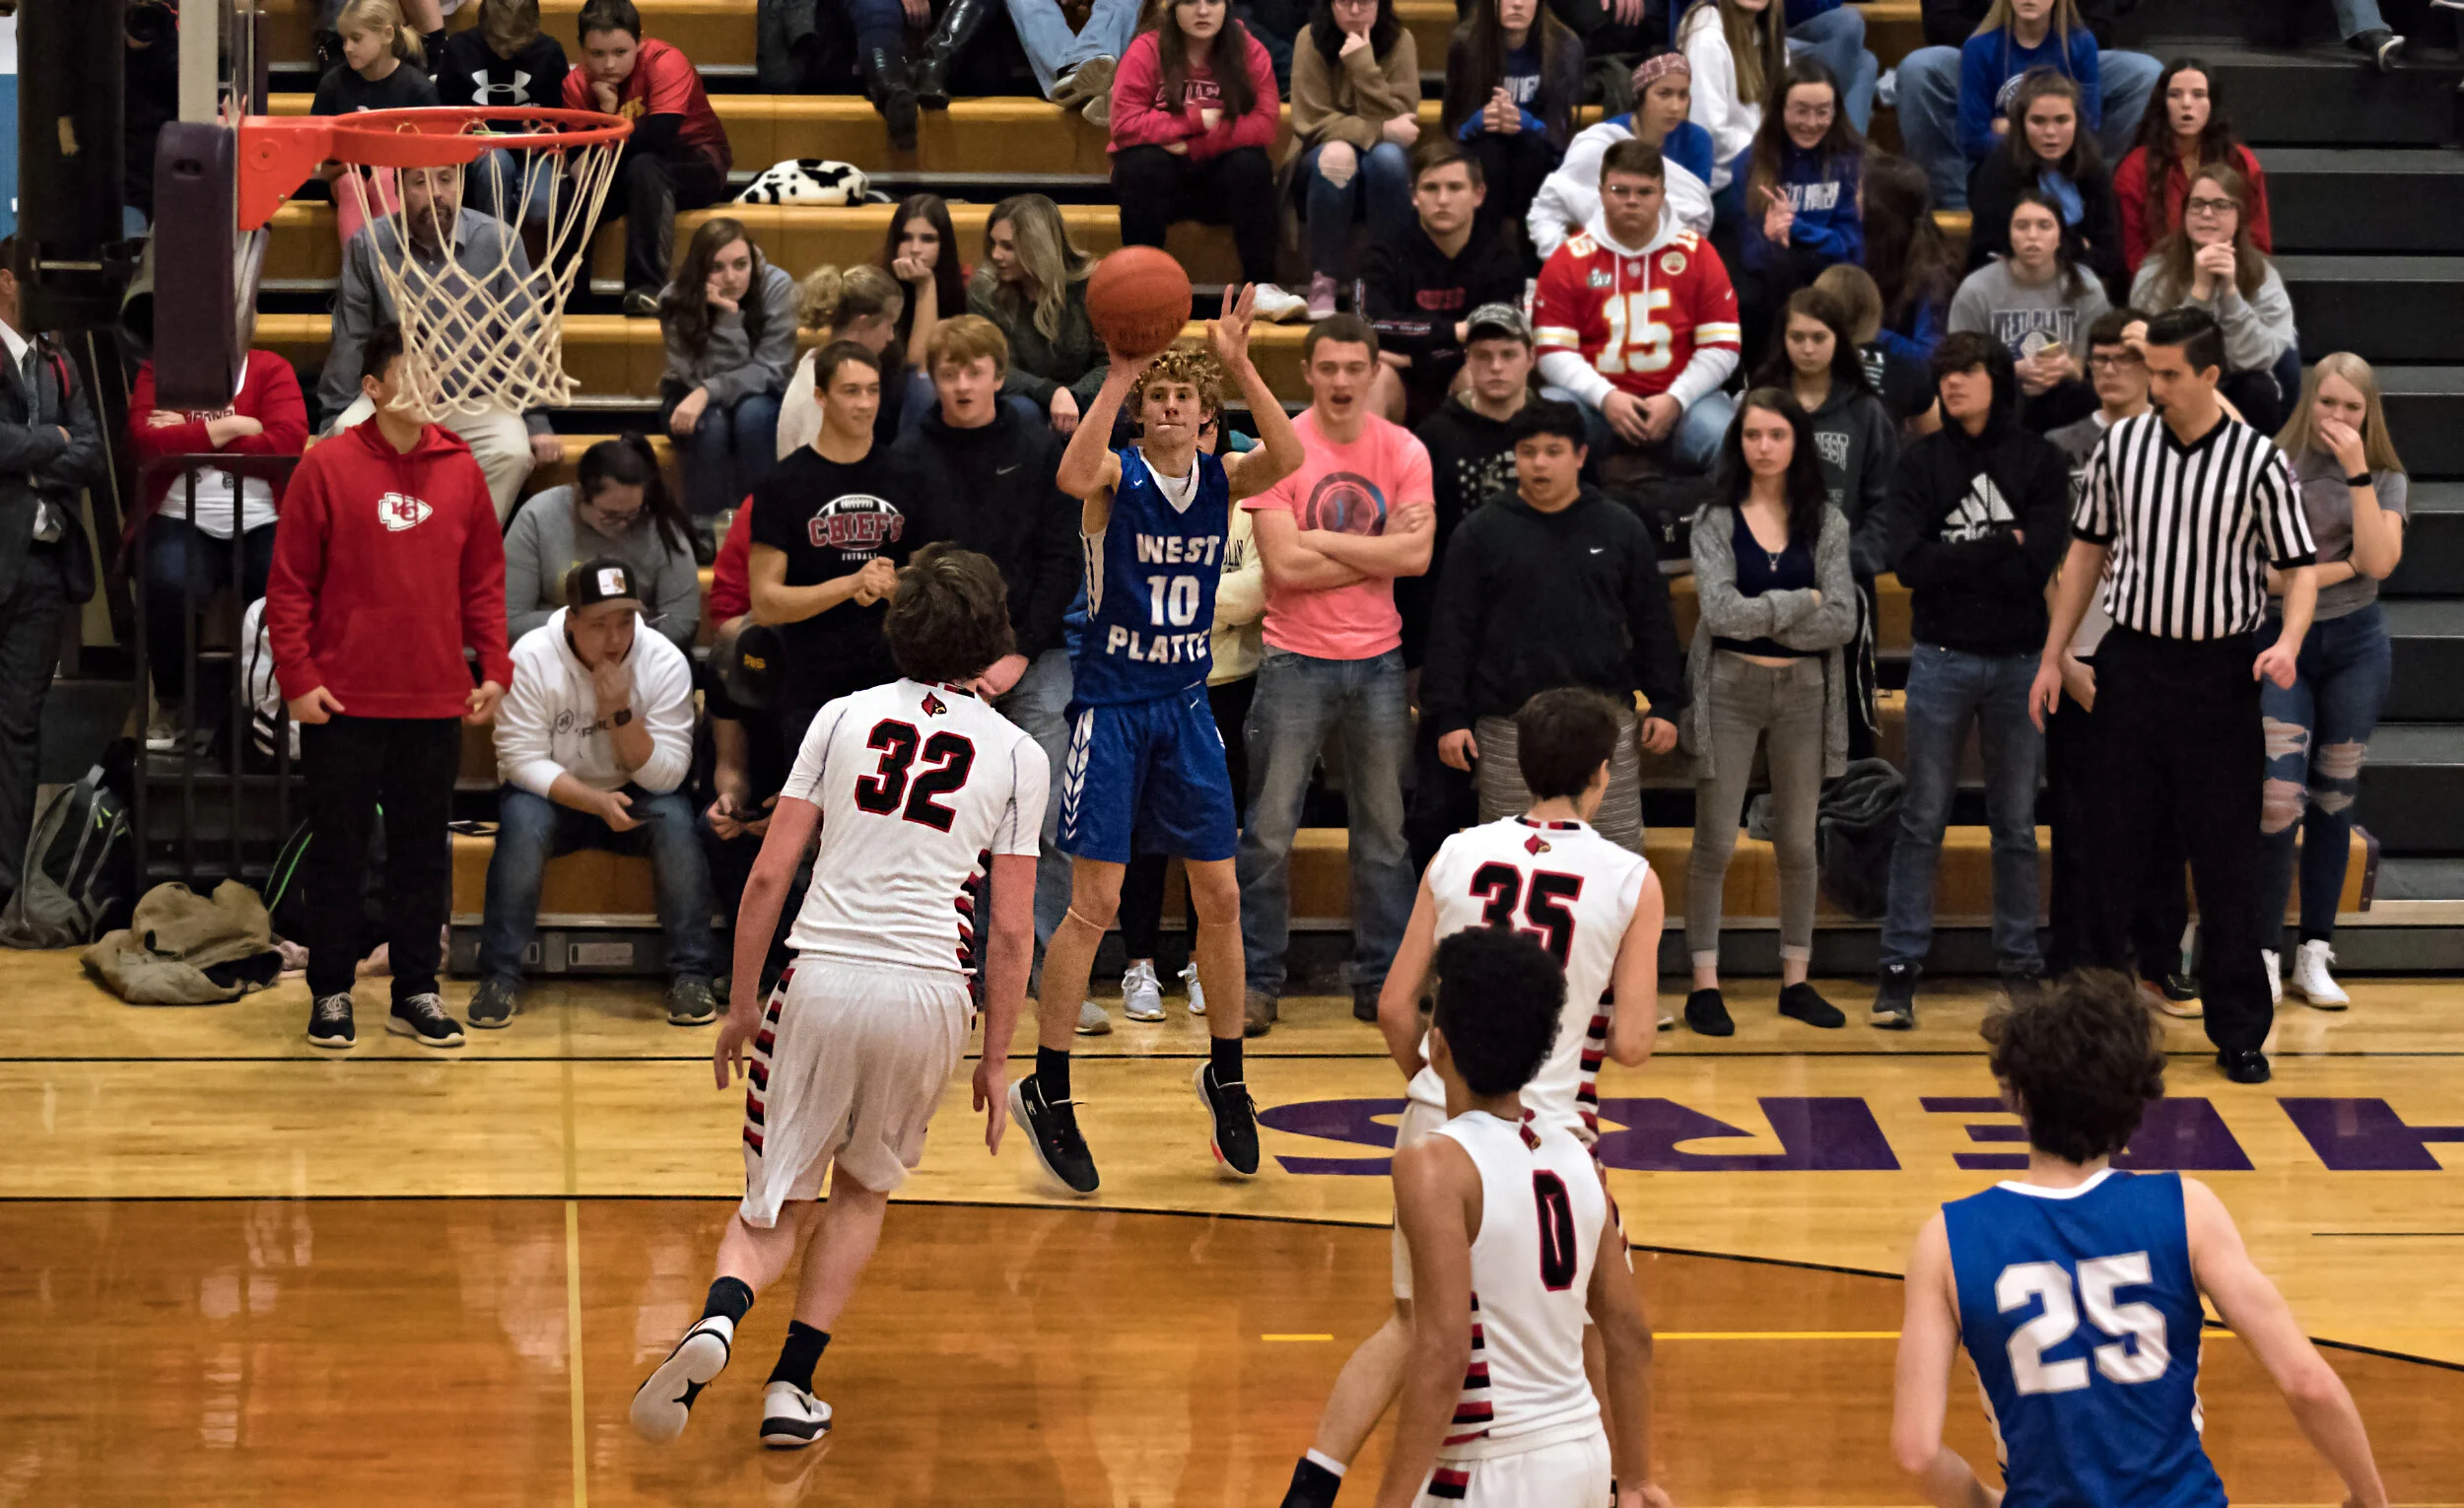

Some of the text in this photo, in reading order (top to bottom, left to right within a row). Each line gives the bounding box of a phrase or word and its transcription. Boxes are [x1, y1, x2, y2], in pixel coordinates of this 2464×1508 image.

[1596, 288, 1673, 374] 15
[808, 512, 905, 547] CHIEFS
[1135, 533, 1220, 567] WEST
[1147, 575, 1200, 627] 10
[1105, 625, 1210, 664] PLATTE
[855, 718, 976, 834] 32
[1469, 860, 1585, 973] 35
[1532, 1169, 1577, 1291] 0
[1994, 1250, 2171, 1397] 25
